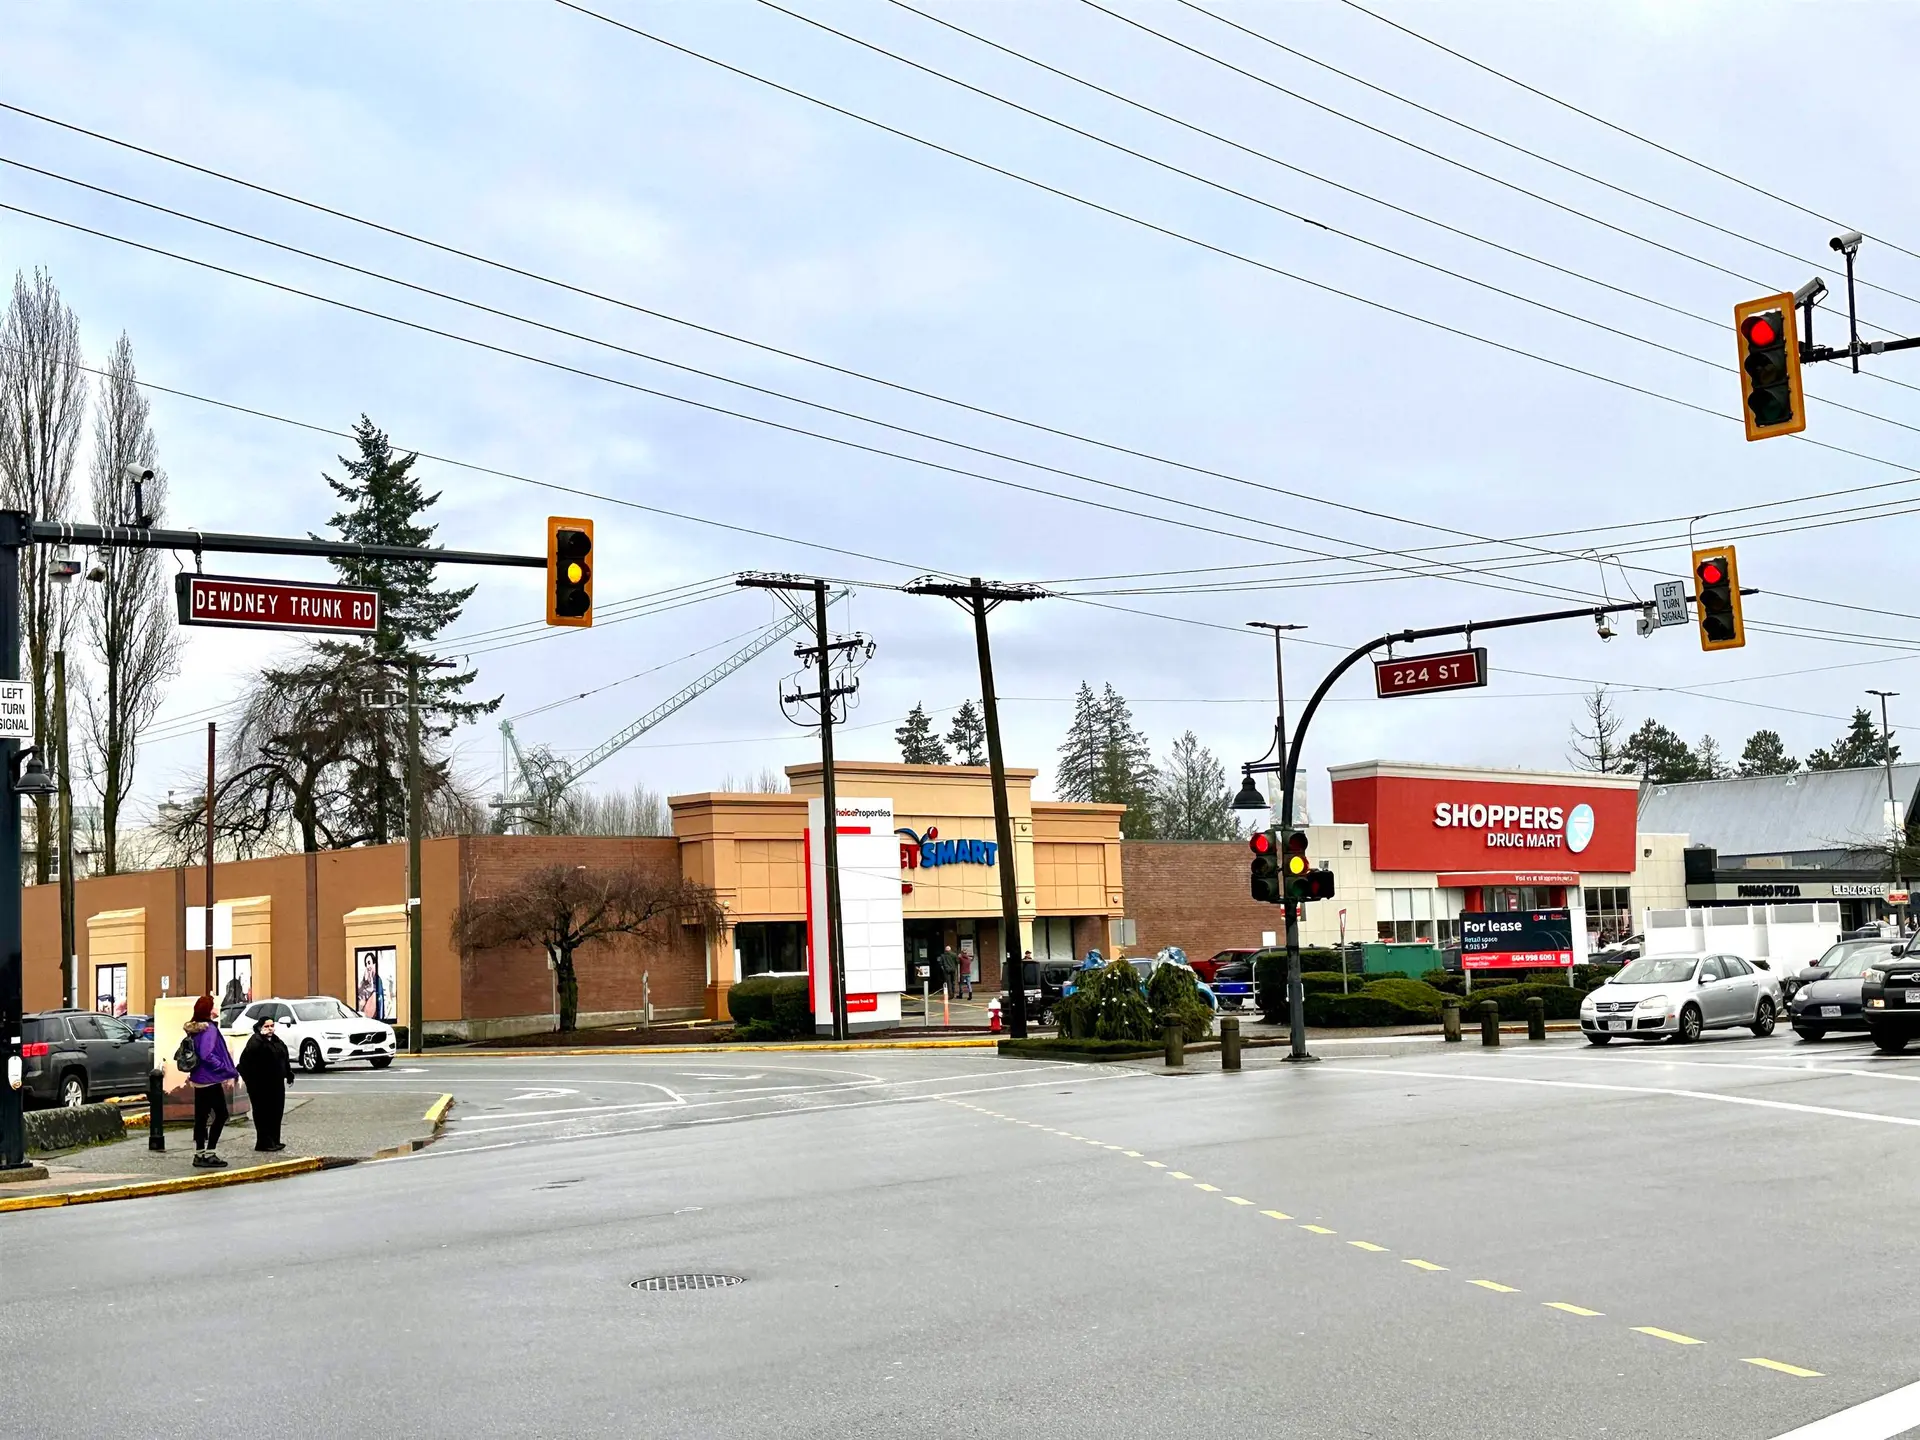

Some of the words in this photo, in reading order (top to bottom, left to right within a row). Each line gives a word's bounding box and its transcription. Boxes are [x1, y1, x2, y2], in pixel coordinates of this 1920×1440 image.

[1662, 586, 1676, 597] LEFT
[196, 589, 279, 615] DEWDNEY
[290, 596, 343, 619] TRUNK
[352, 601, 373, 621] RD
[1662, 598, 1680, 610] TURN
[1661, 609, 1685, 622] SIGNAL
[1393, 667, 1430, 685] 224
[1438, 663, 1460, 680] ST
[2, 687, 24, 700] LEFT
[1, 702, 26, 715] TURN
[1433, 802, 1564, 830] SHOPPERS
[1487, 833, 1524, 848] DRUG
[1526, 834, 1563, 848] MART
[1774, 885, 1801, 897] PIZZA
[1857, 885, 1885, 896] COFFEE
[1464, 921, 1486, 933] For
[1488, 920, 1522, 932] lease
